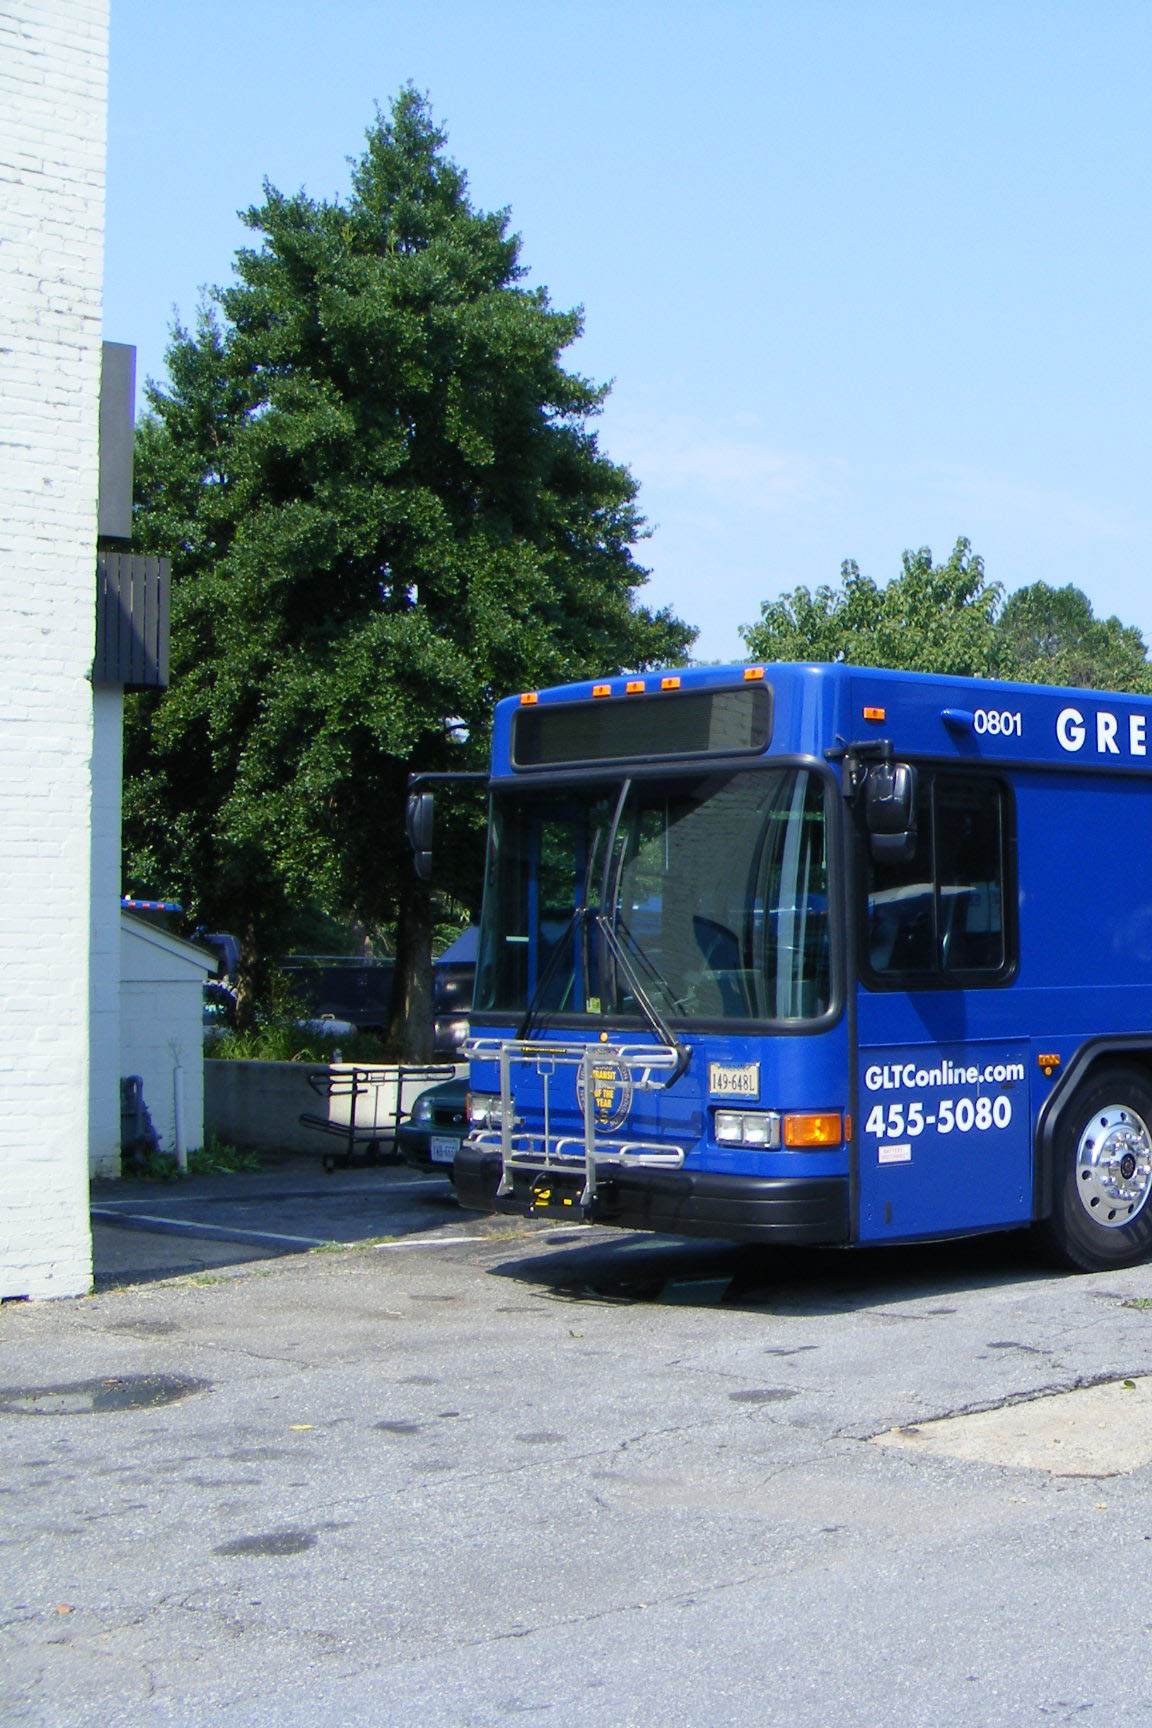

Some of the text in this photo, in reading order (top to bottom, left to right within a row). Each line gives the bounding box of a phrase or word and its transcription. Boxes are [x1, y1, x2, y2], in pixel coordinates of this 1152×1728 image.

[973, 709, 1022, 737] 0801
[592, 1069, 616, 1080] TRANSIT
[713, 1073, 755, 1091] 149-648L
[865, 1060, 1025, 1091] GLTConline.com
[593, 1089, 614, 1099] OF THE
[596, 1098, 612, 1108] YEAR
[865, 1095, 1012, 1138] 455-5080
